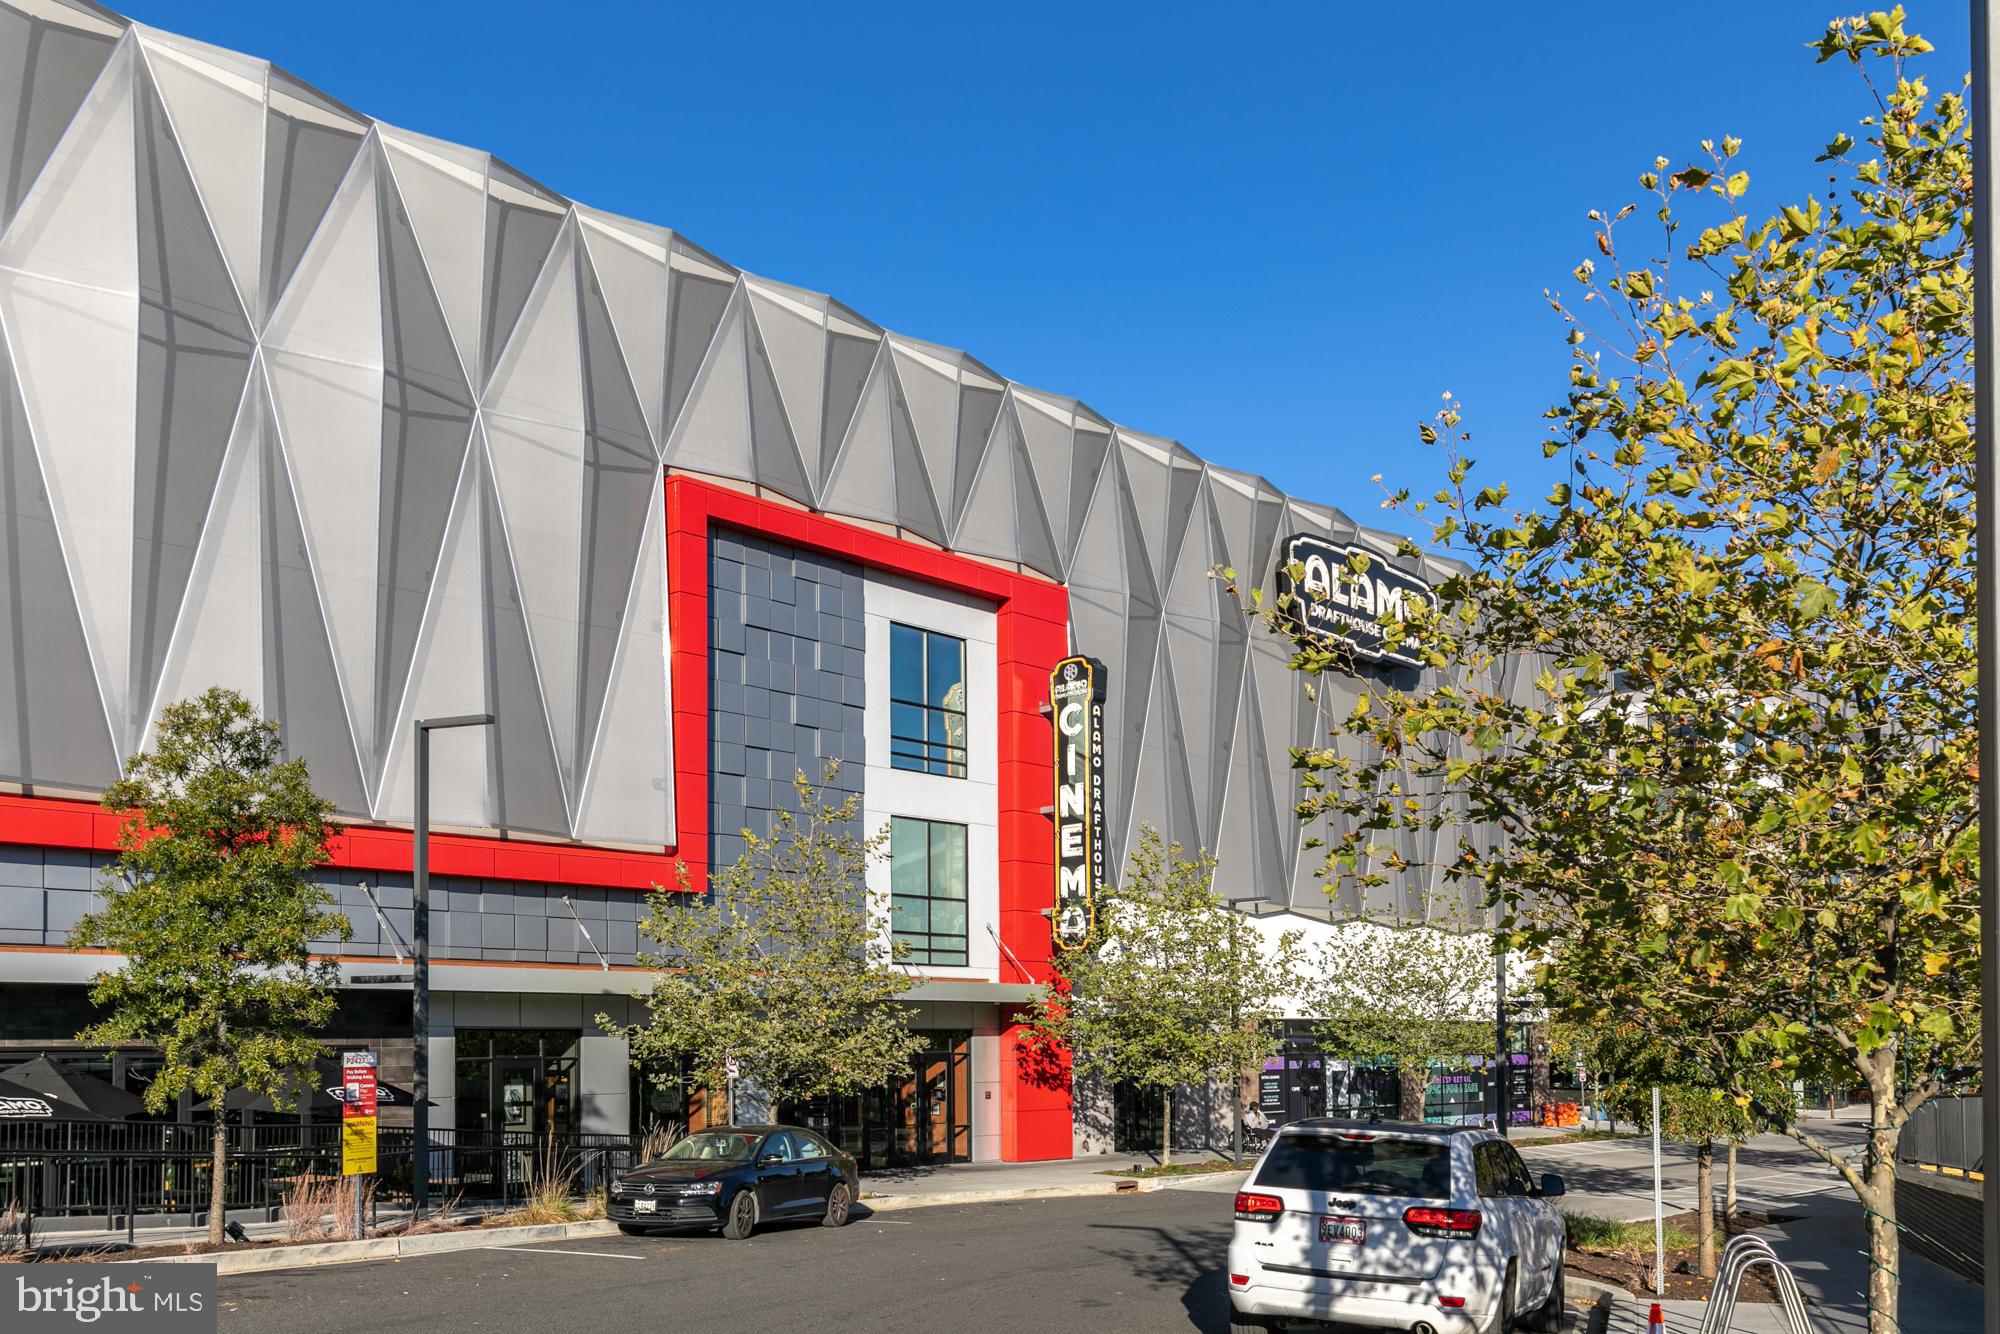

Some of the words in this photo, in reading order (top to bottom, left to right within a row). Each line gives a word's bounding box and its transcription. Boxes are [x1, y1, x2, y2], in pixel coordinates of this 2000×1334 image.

[1310, 602, 1382, 637] DRAFTHOUSE
[1092, 704, 1102, 768] ALAMO
[1058, 702, 1087, 939] CINEMA
[1093, 774, 1103, 902] DRAFTHOUSE
[346, 1057, 365, 1065] P2427
[346, 1120, 375, 1128] WARNING
[1328, 1197, 1357, 1211] Jeep
